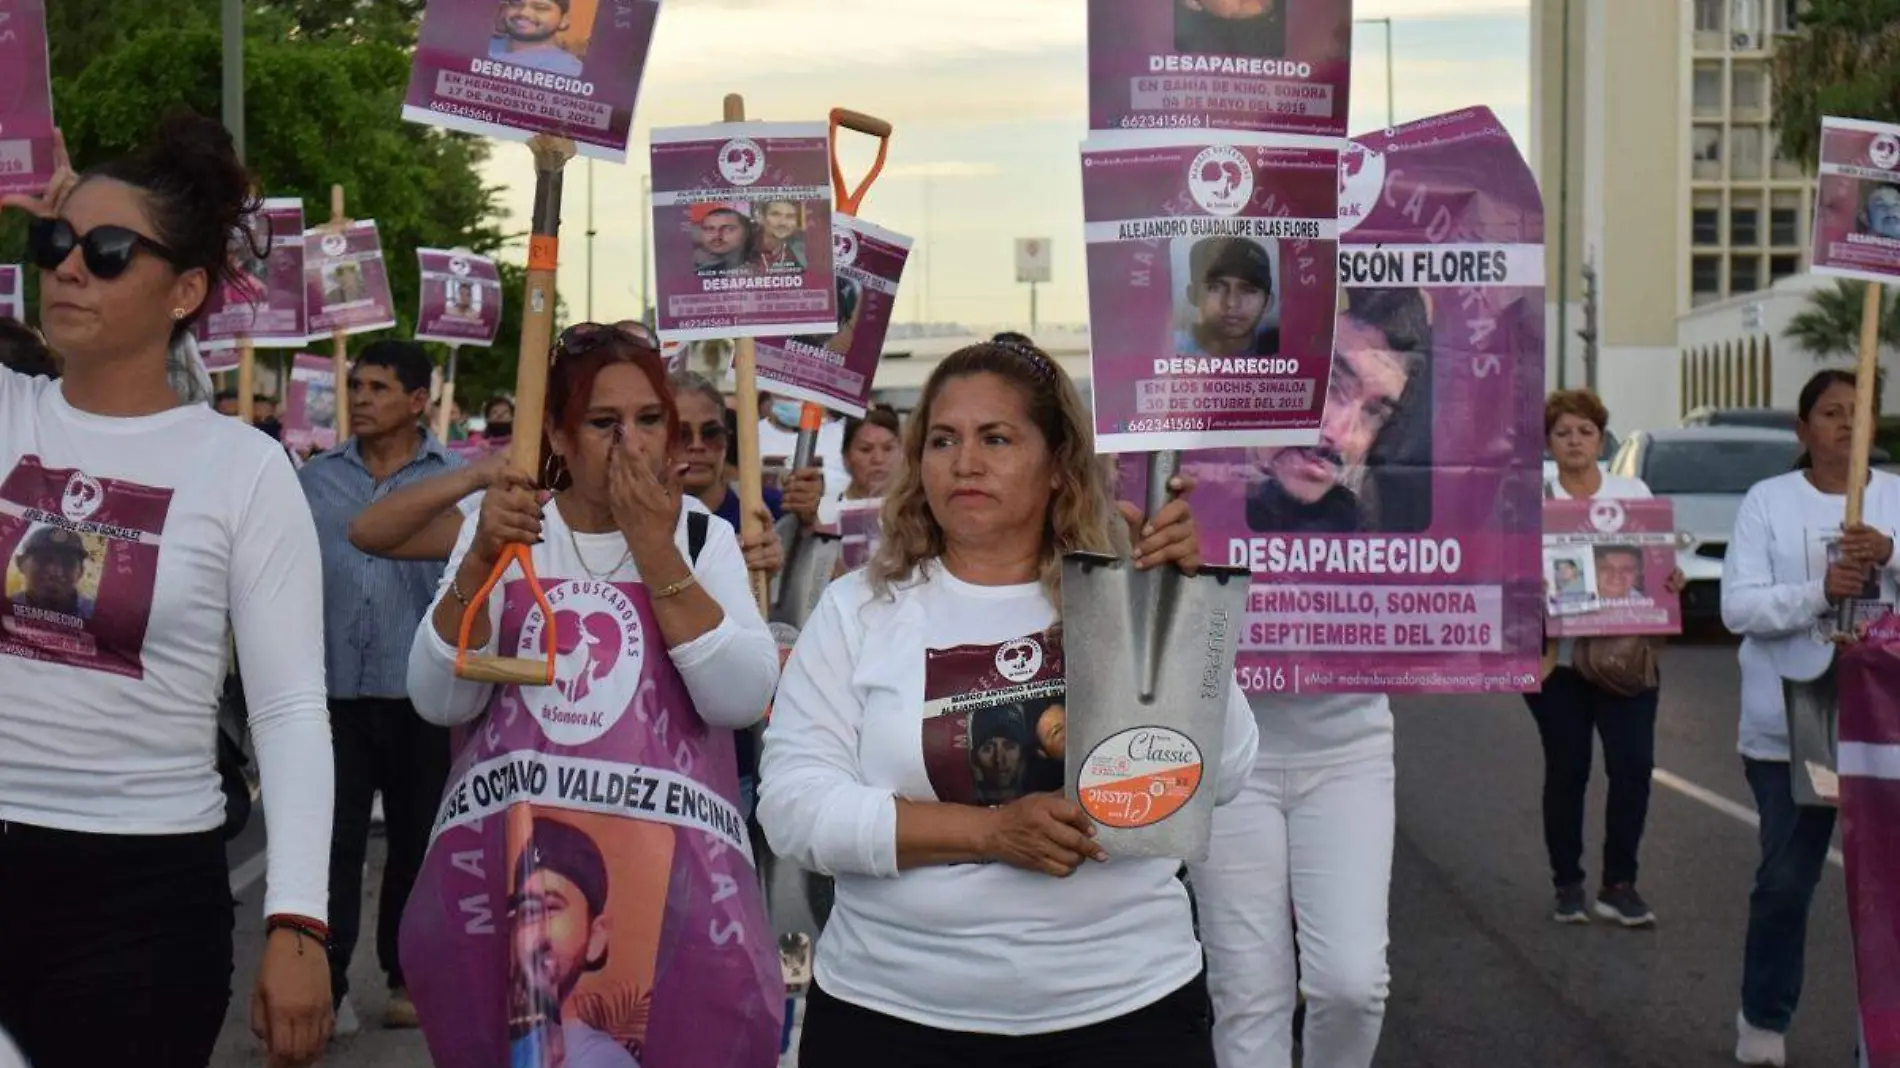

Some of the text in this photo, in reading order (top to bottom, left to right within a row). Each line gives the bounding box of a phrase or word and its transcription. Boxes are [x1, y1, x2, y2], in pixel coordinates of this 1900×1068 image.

[1149, 55, 1311, 78] DESAPARECIDO
[470, 58, 595, 97] DESAPARECIDO
[1138, 80, 1158, 92] EN
[1212, 82, 1229, 93] DE
[1274, 87, 1328, 99] SONORA
[1206, 98, 1245, 110] MAYO
[1121, 115, 1201, 129] 6623415616
[1118, 218, 1320, 239] ALEJANDRO GUADALUPE ISLAS FLORES
[1412, 251, 1507, 282] FLORES
[702, 276, 803, 291] DESAPARECIDO
[1153, 358, 1299, 375] DESAPARECIDO
[1144, 381, 1307, 396] EN LOS MOCHIS, SINALOA
[1169, 399, 1188, 410] DE
[1254, 398, 1275, 409] DEL
[1128, 418, 1204, 433] 6623415616
[1229, 537, 1462, 573] DESAPARECIDO
[1386, 593, 1477, 614] SONORA
[12, 603, 85, 629] DESAPARECIDO
[1250, 623, 1491, 645] SEPTIEMBRE DEL 2016
[1128, 731, 1193, 762] Classic
[557, 765, 660, 811] VALDÉZ
[665, 781, 742, 845] ENCINAS
[1088, 790, 1152, 822] Classic
